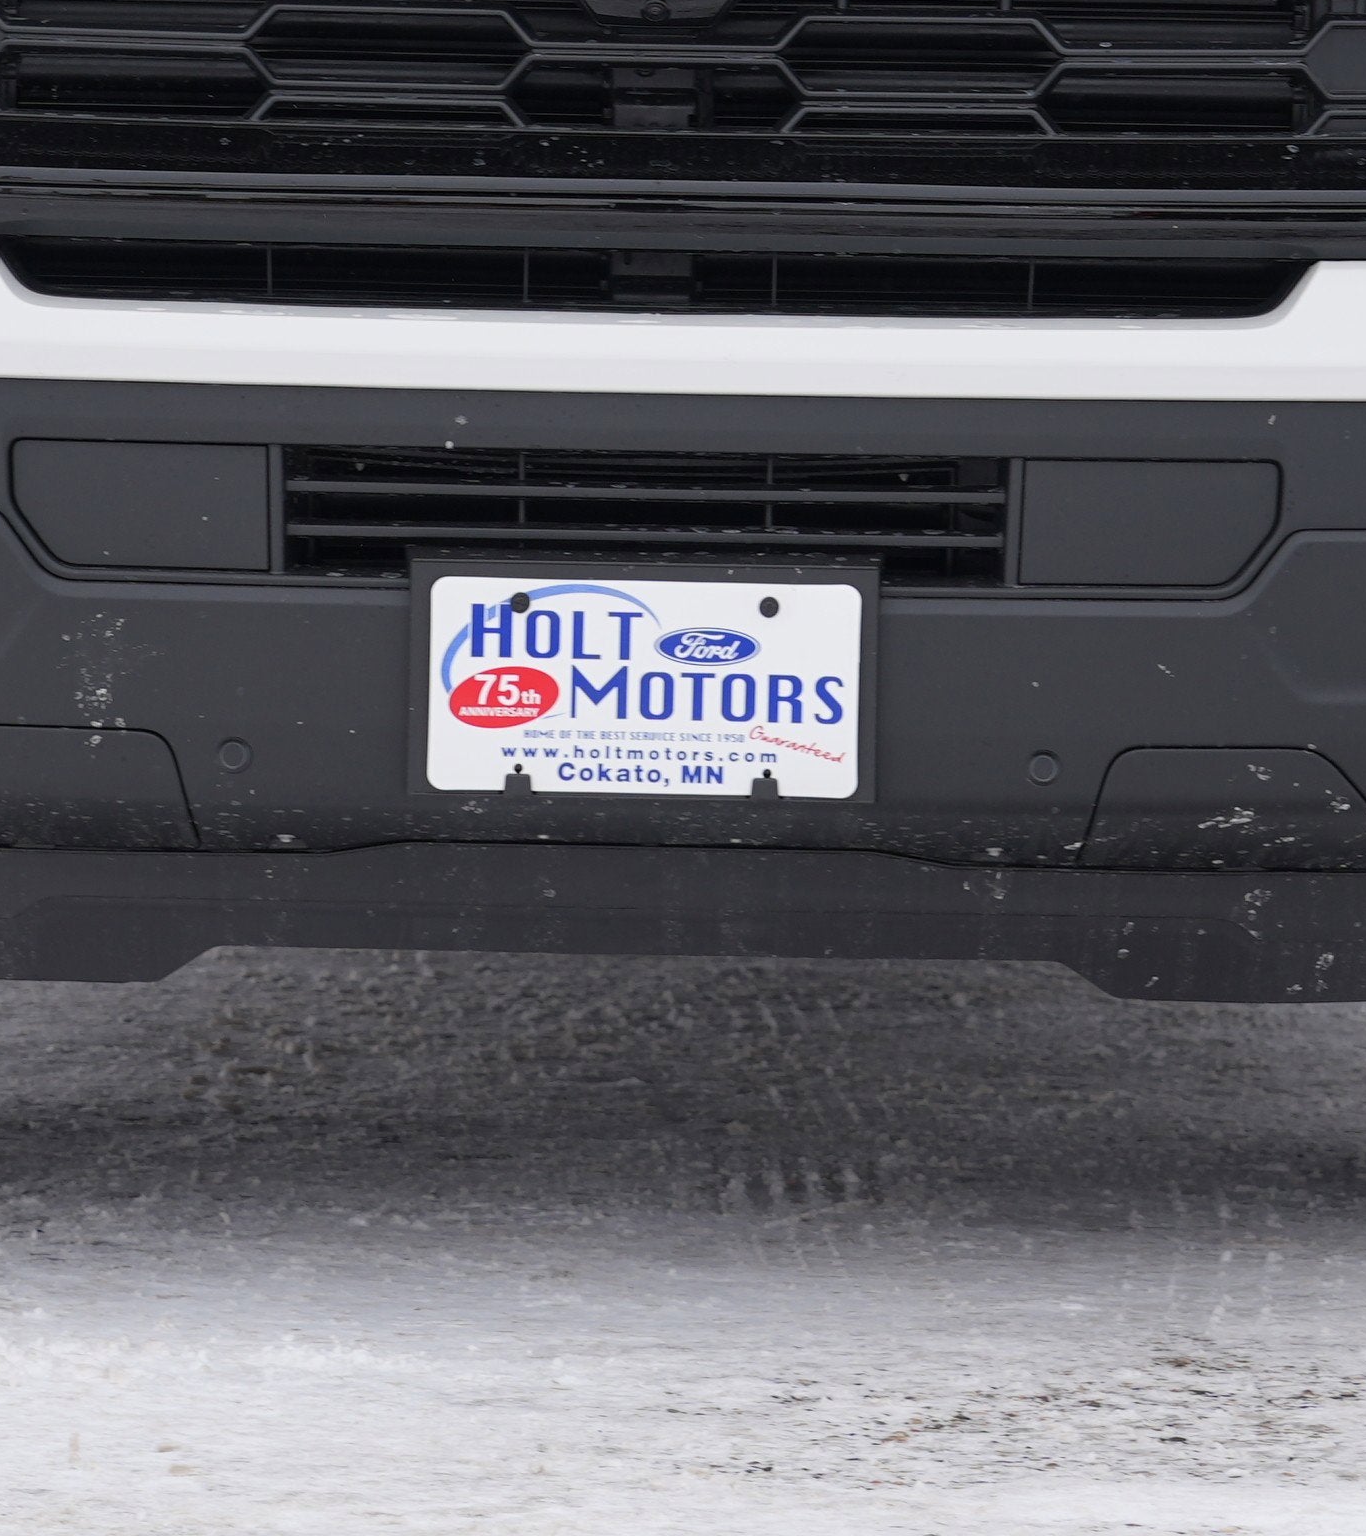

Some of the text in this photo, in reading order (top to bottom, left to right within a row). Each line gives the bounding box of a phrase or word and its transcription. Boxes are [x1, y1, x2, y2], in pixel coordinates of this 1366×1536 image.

[471, 603, 643, 660] HOLT
[674, 632, 741, 660] Ford
[474, 674, 542, 706] 75th
[571, 664, 844, 725] MOTORS
[458, 706, 540, 717] ANNIVERSARY
[524, 730, 554, 739] HOME
[559, 730, 572, 739] OF
[577, 731, 596, 739] THE
[600, 731, 626, 740] BEST
[680, 733, 711, 742] SINCE
[749, 725, 847, 763] Guaranteed
[502, 745, 777, 763] www.holtmotors.com
[558, 762, 723, 786] Cokato, MN
